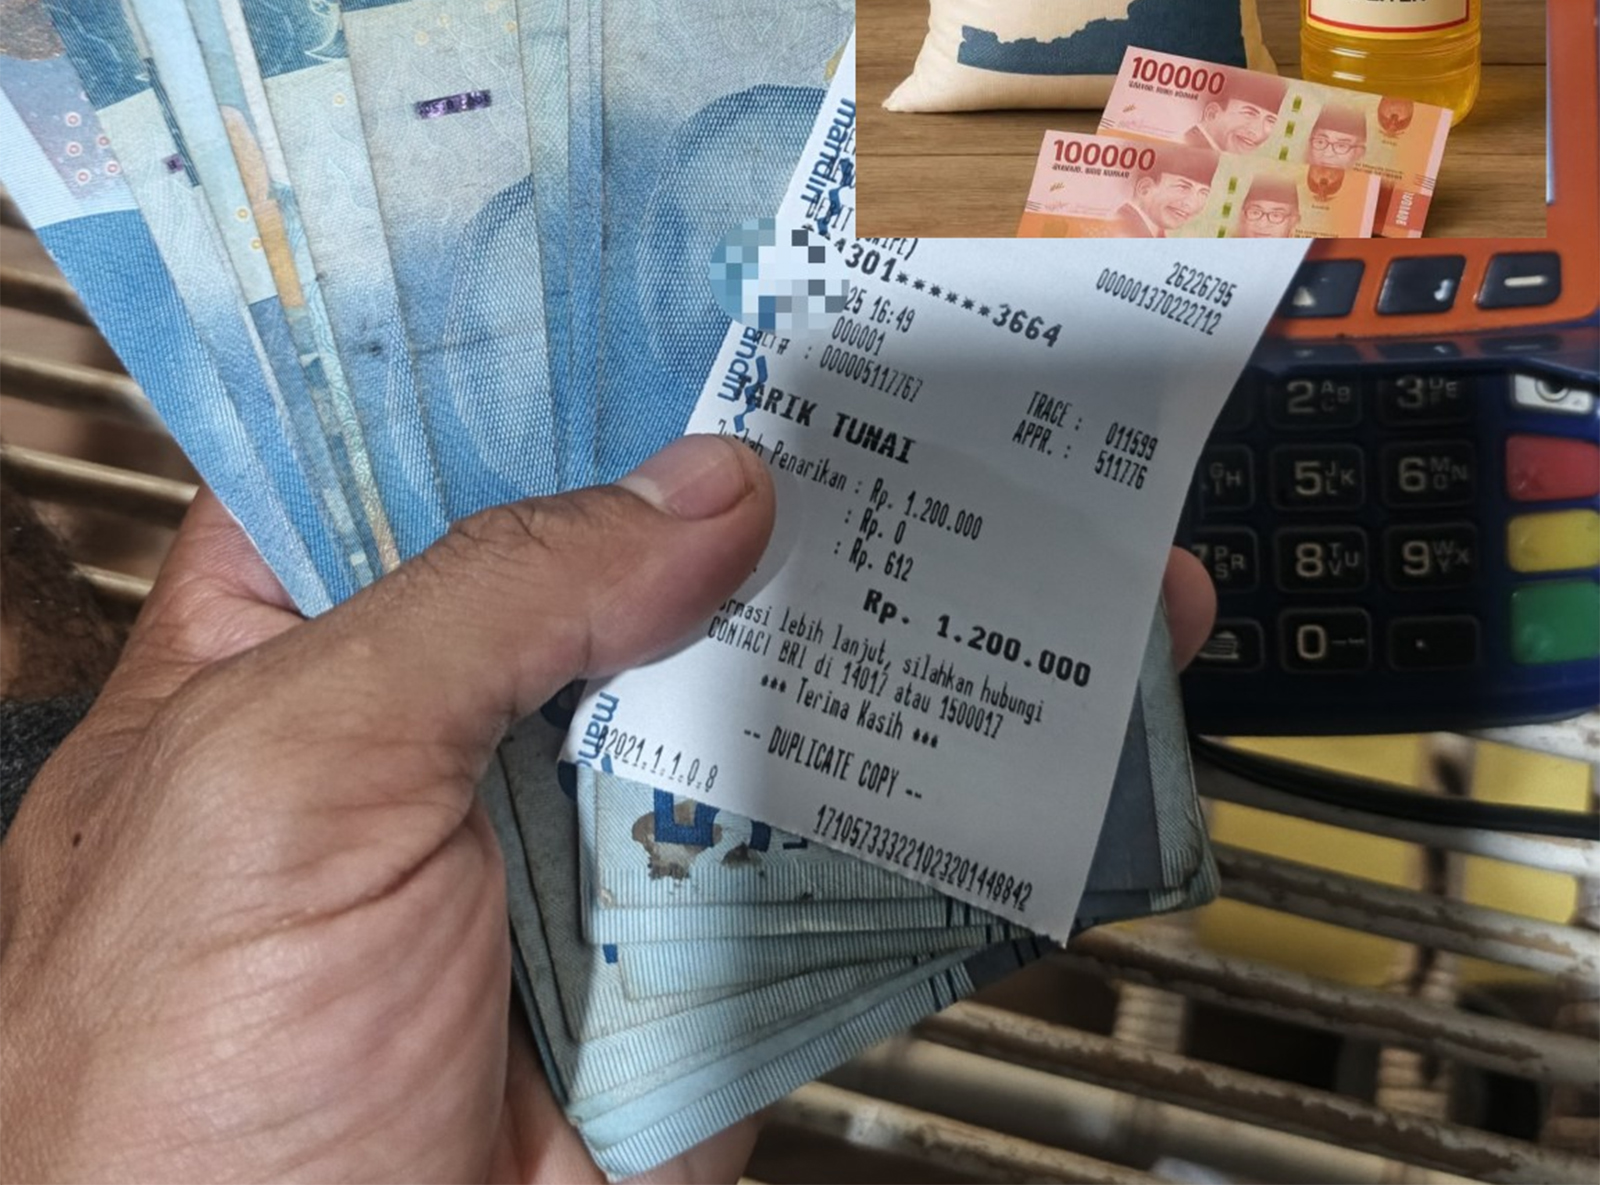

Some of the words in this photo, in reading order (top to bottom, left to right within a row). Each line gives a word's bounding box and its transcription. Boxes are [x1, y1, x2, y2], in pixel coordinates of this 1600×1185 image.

[1132, 56, 1225, 95] 100000
[1053, 139, 1156, 171] 100000
[834, 238, 1062, 347] 3013664
[1096, 268, 1222, 336] 000001370222712
[1165, 262, 1237, 308] 26226795
[832, 316, 886, 356] 000001
[873, 296, 916, 333] 16:49
[717, 326, 758, 402] andiri
[819, 345, 924, 403] 000005117767
[1287, 380, 1316, 414] 2
[1395, 375, 1424, 409] 3
[832, 412, 917, 464] TUNAI
[1026, 390, 1073, 428] TRACE
[1105, 422, 1159, 461] 011599
[717, 419, 764, 458] Jlah
[769, 440, 848, 492] Penarikan
[869, 478, 893, 512] Rp.
[903, 490, 983, 541] 1.200.000
[1012, 420, 1053, 456] APPR.
[1094, 450, 1148, 490] 511776
[1295, 461, 1323, 496] 5
[1399, 457, 1427, 493] 6
[859, 507, 883, 541] Rp.
[894, 520, 907, 545] 0
[849, 537, 873, 572] Rp.
[884, 551, 914, 582] 612
[1295, 543, 1323, 578] 8
[1402, 540, 1430, 576] 9
[862, 588, 910, 625] Rp.
[937, 614, 1092, 688] 1.200.000
[1297, 624, 1326, 659] 0
[779, 606, 824, 645] lebih
[832, 623, 891, 672] lanjut,
[902, 654, 974, 697] silahkan
[980, 675, 1044, 726] hubungi
[796, 677, 851, 721] Terima
[857, 699, 904, 741] Kasih
[814, 654, 835, 679] di
[841, 660, 889, 698] 14017
[894, 682, 932, 714] atau
[939, 695, 1004, 740] 1500017
[768, 725, 855, 781] DUPLICATE
[858, 759, 899, 798] COPY
